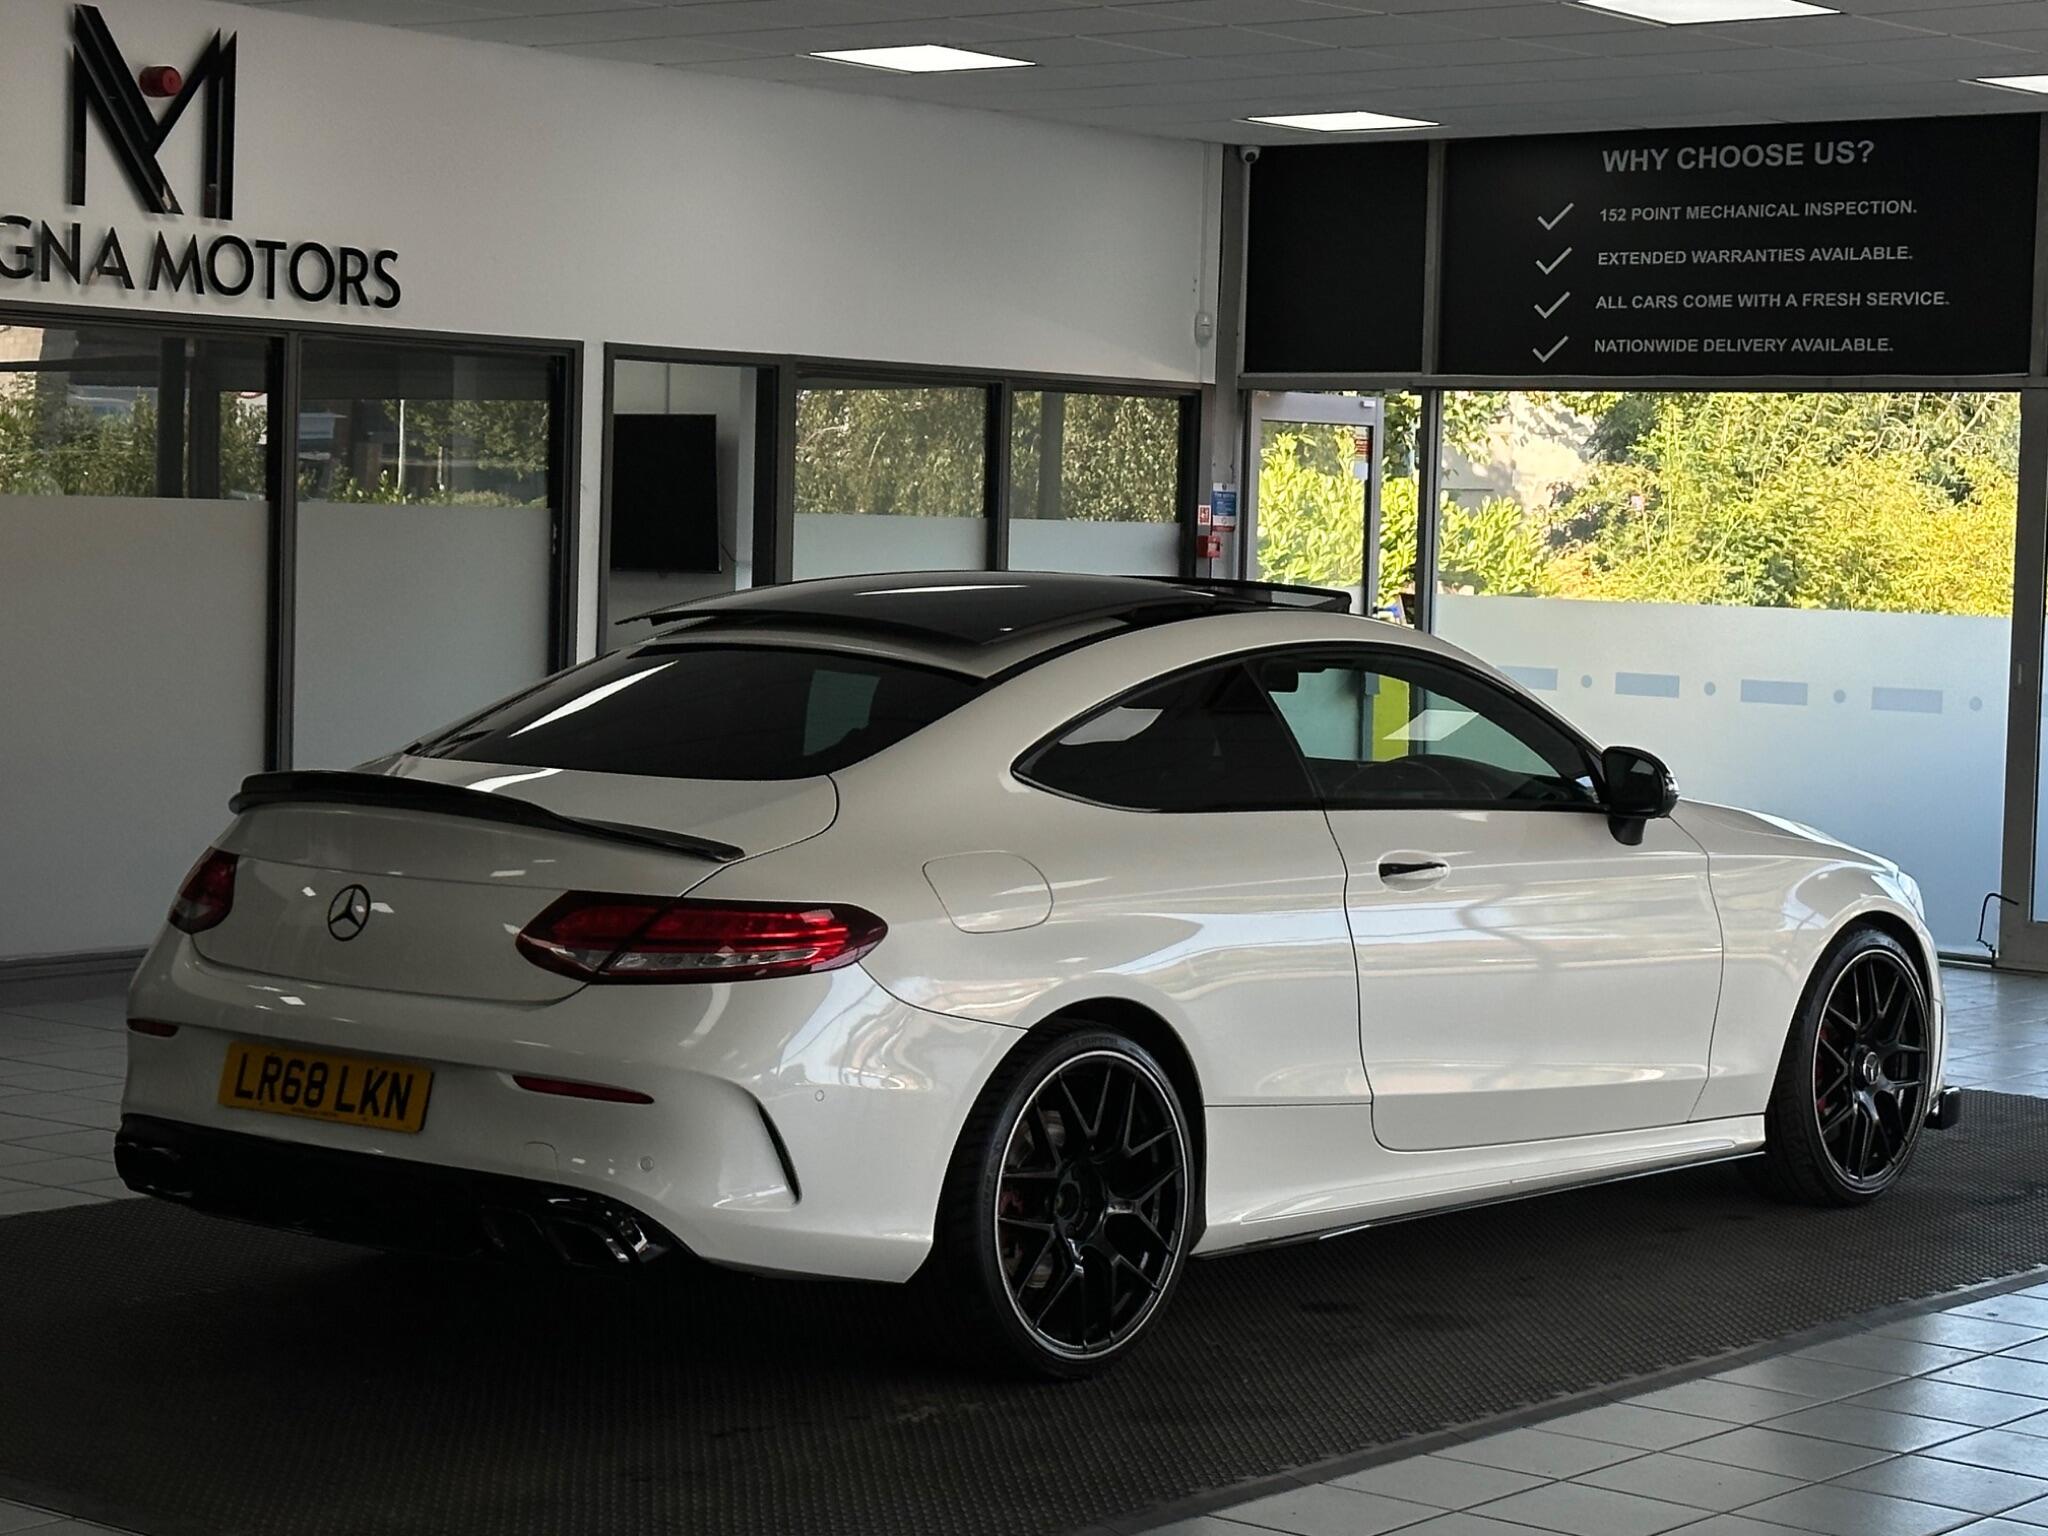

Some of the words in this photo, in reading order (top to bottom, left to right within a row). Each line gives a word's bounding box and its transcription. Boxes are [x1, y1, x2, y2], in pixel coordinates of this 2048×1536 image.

[1603, 148, 1669, 172] WHY
[1677, 143, 1803, 170] CHOOSE
[1814, 140, 1875, 165] US?
[1600, 208, 1627, 222] 152
[1631, 206, 1681, 221] POINT
[1686, 203, 1800, 220] MECHANICAL
[1804, 200, 1918, 217] INSPECTION.
[1598, 251, 1687, 266] EXTENDED
[1691, 248, 1805, 264] WARRANTIES
[1809, 246, 1913, 262] AVAILABLE.
[149, 230, 402, 309] MOTORS
[1595, 296, 1628, 310] ALL
[1632, 295, 1679, 309] CARS
[1683, 294, 1733, 308] COME
[1738, 293, 1781, 308] WITH
[1784, 293, 1798, 307] A
[1802, 292, 1861, 307] FRESH
[1866, 291, 1950, 306] SERVICE.
[1594, 339, 1699, 353] NATIONWIDE
[1703, 338, 1788, 352] DELIVERY
[1791, 338, 1894, 352] AVAILABLE.
[234, 1052, 328, 1108] LR68
[335, 1066, 413, 1121] LKN
